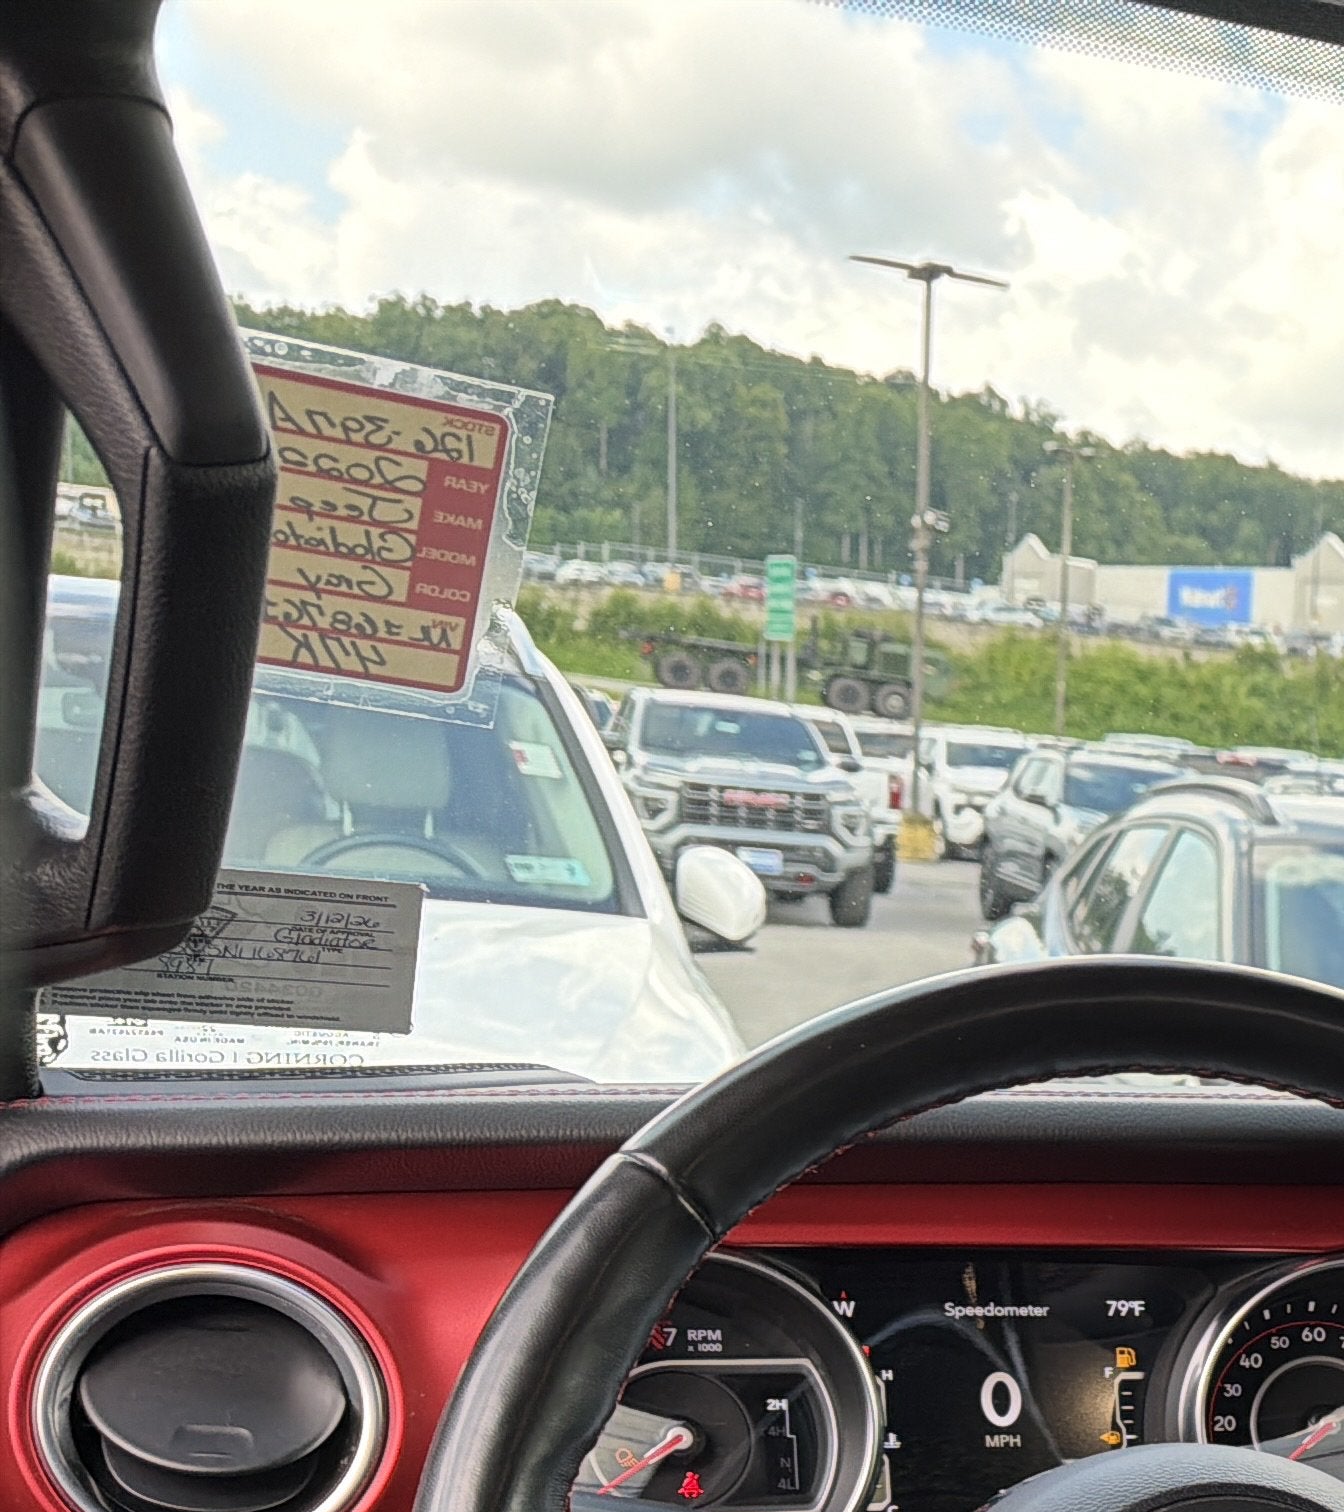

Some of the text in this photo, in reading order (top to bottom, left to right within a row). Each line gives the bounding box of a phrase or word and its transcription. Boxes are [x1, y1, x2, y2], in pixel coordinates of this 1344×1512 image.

[238, 884, 266, 893] YEAR
[267, 886, 282, 894] AS
[284, 888, 337, 898] INDICATED
[338, 892, 354, 900] ON
[355, 894, 390, 903] FRONT
[833, 1300, 856, 1318] W
[944, 1302, 1050, 1319] Speedometer
[1106, 1300, 1146, 1318] 79°F
[664, 1328, 677, 1346] 7
[687, 1329, 722, 1342] RPM
[1301, 1327, 1326, 1342] 60
[697, 1343, 722, 1353] 1000
[1270, 1336, 1290, 1349] 50
[1240, 1353, 1263, 1369] 40
[881, 1370, 894, 1381] H
[1223, 1384, 1242, 1398] 30
[766, 1399, 787, 1411] 2H
[980, 1372, 1022, 1428] 0
[1213, 1415, 1237, 1432] 20
[985, 1434, 1022, 1449] MPH
